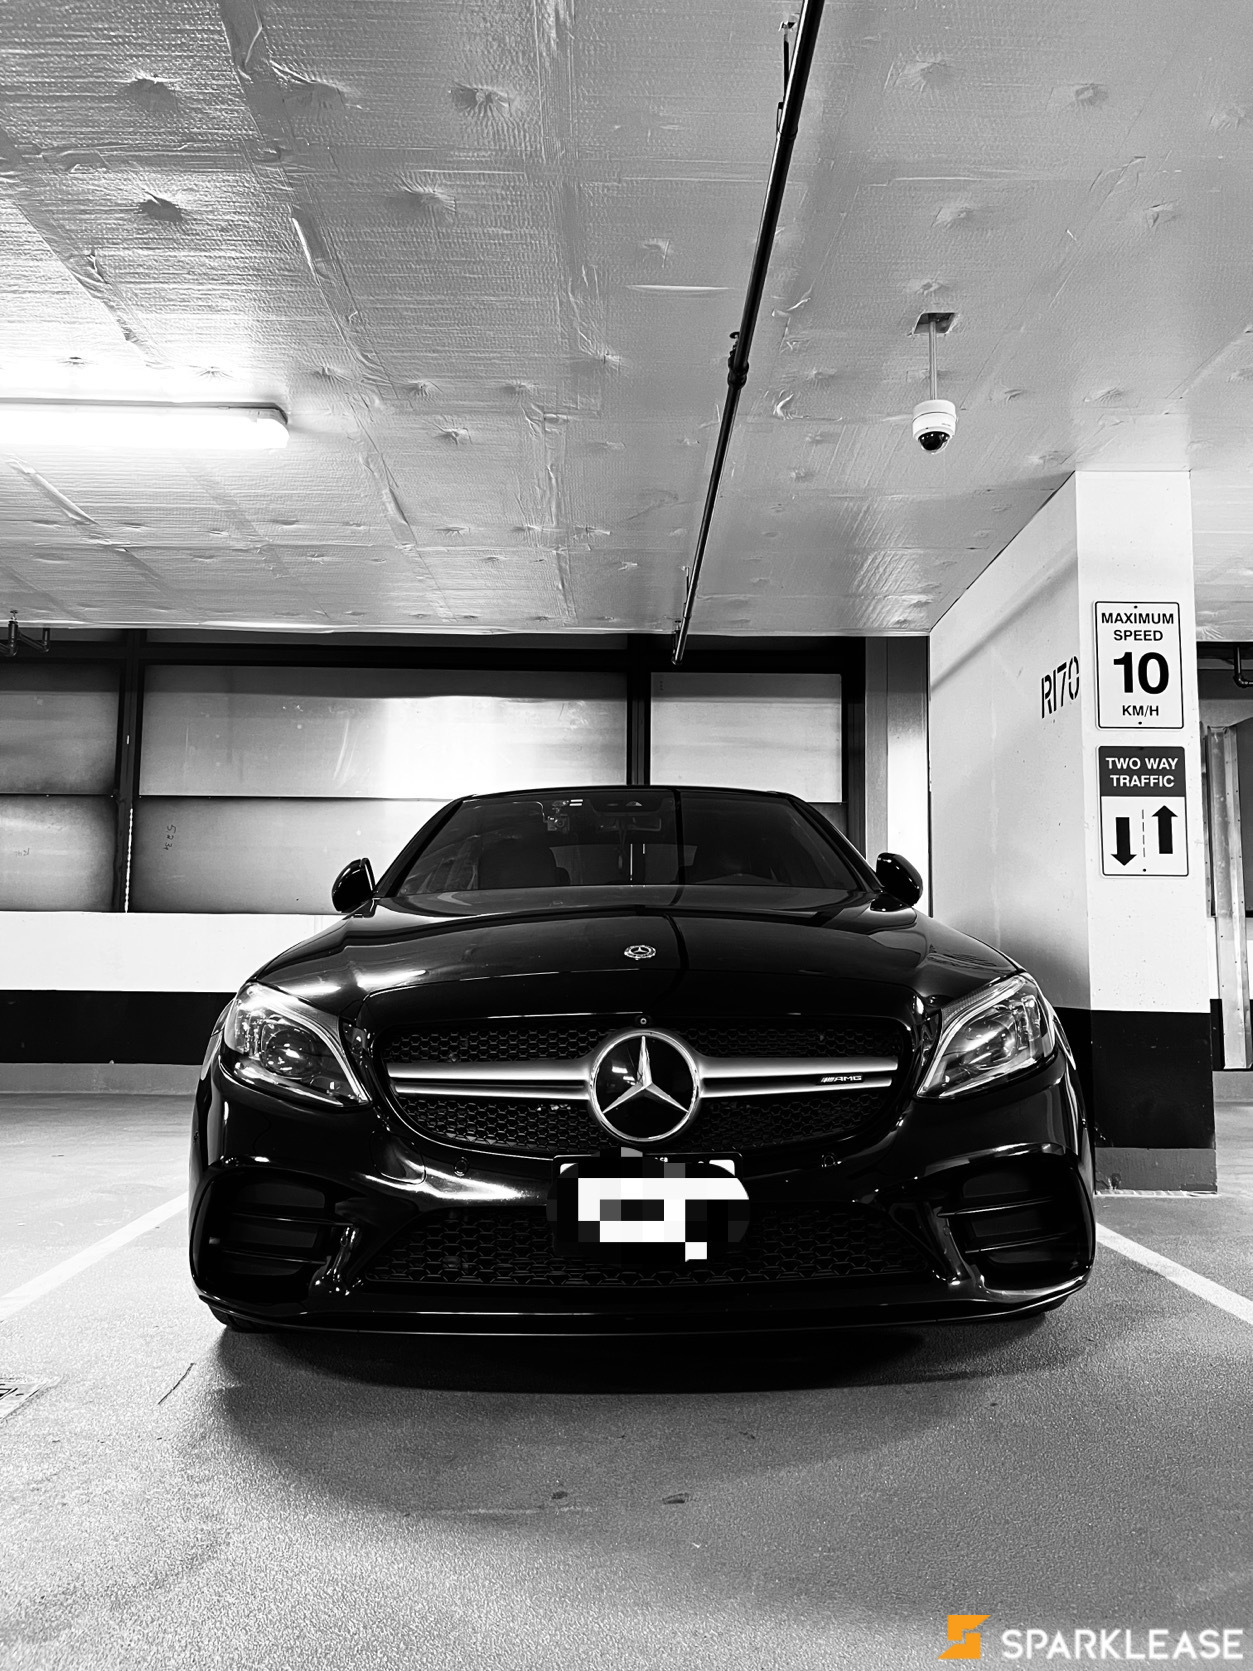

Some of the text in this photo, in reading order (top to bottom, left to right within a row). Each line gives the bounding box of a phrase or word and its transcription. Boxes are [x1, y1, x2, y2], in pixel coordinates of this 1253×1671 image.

[1101, 612, 1174, 624] MAXIMUM
[1113, 629, 1164, 641] SPEED
[1113, 651, 1170, 694] 10
[1122, 704, 1159, 717] KM/H
[1105, 757, 1178, 770] TWO WAY
[1109, 774, 1175, 788] TRAFFIC
